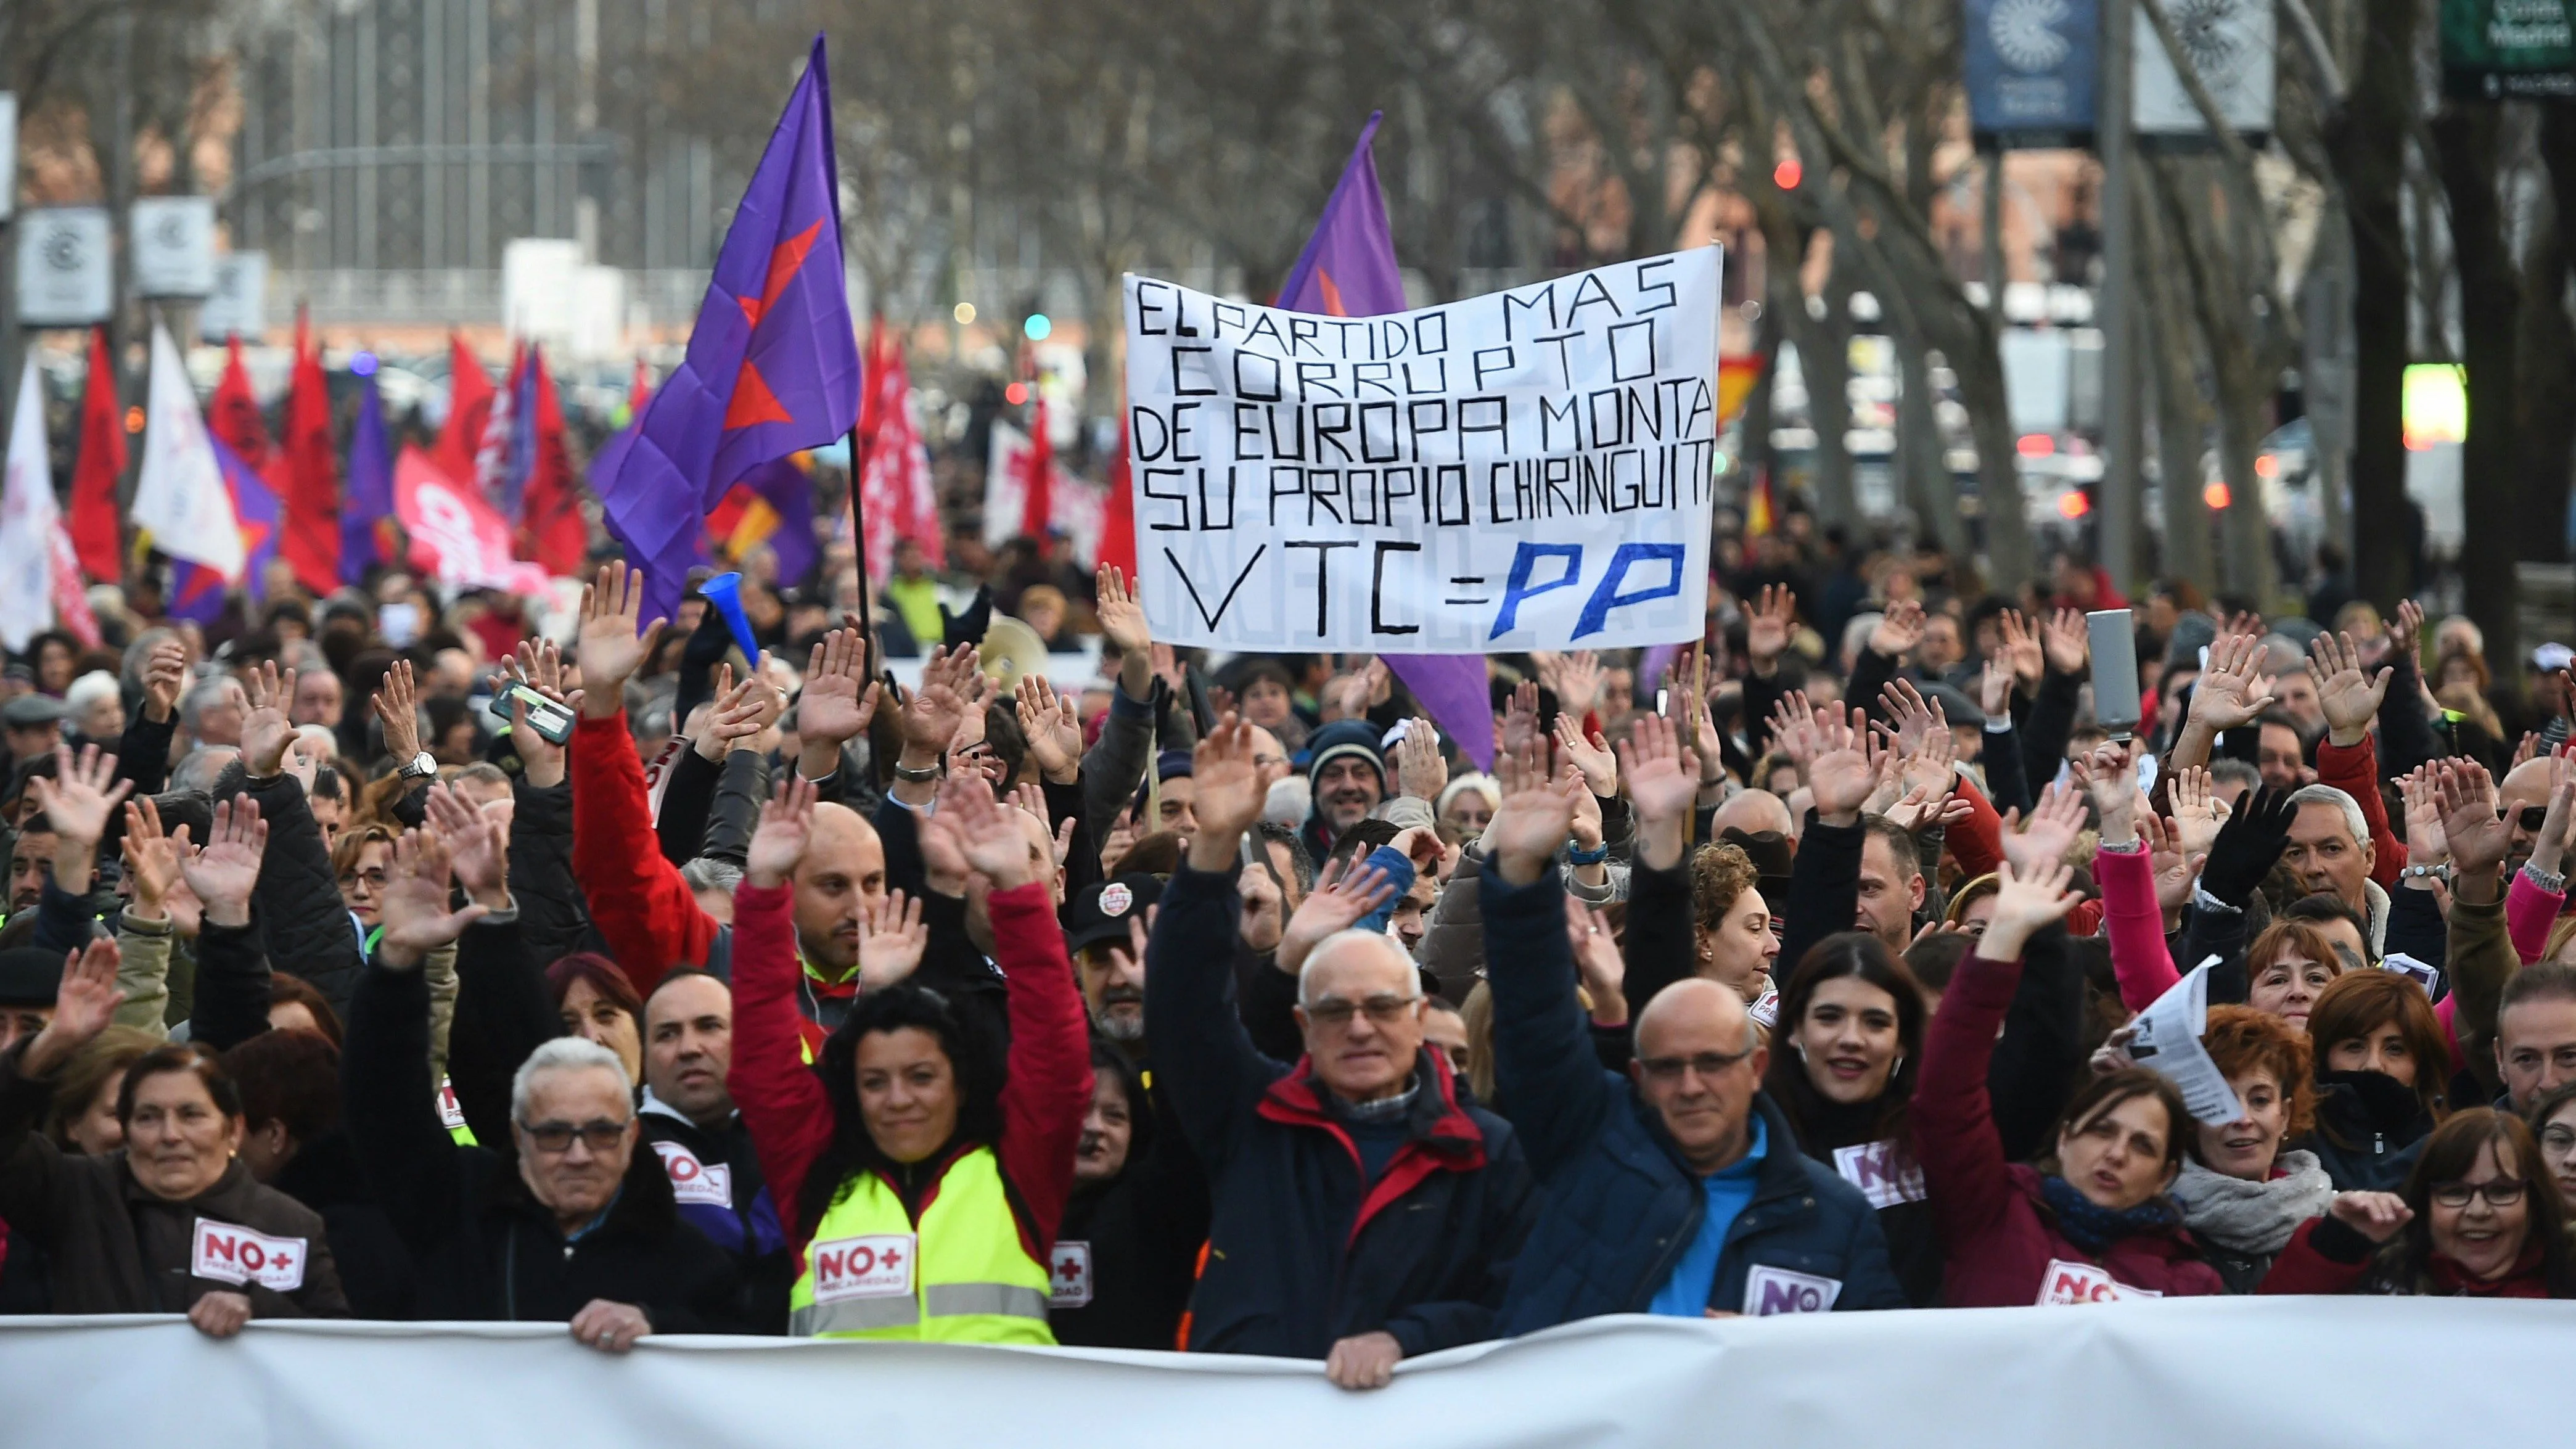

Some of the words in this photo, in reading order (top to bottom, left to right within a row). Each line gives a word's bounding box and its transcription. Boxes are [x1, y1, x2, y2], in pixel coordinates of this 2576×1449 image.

[1137, 281, 1197, 337] EL
[1213, 301, 1448, 361] PARTIDO
[1503, 258, 1676, 342] MAS
[1171, 317, 1655, 402] CORRUPTO
[1133, 402, 1201, 462] DE
[1235, 395, 1508, 464] EUROPA
[1540, 376, 1712, 451] MONTA
[1144, 466, 1236, 531] SU
[1270, 466, 1470, 527] PROPIO
